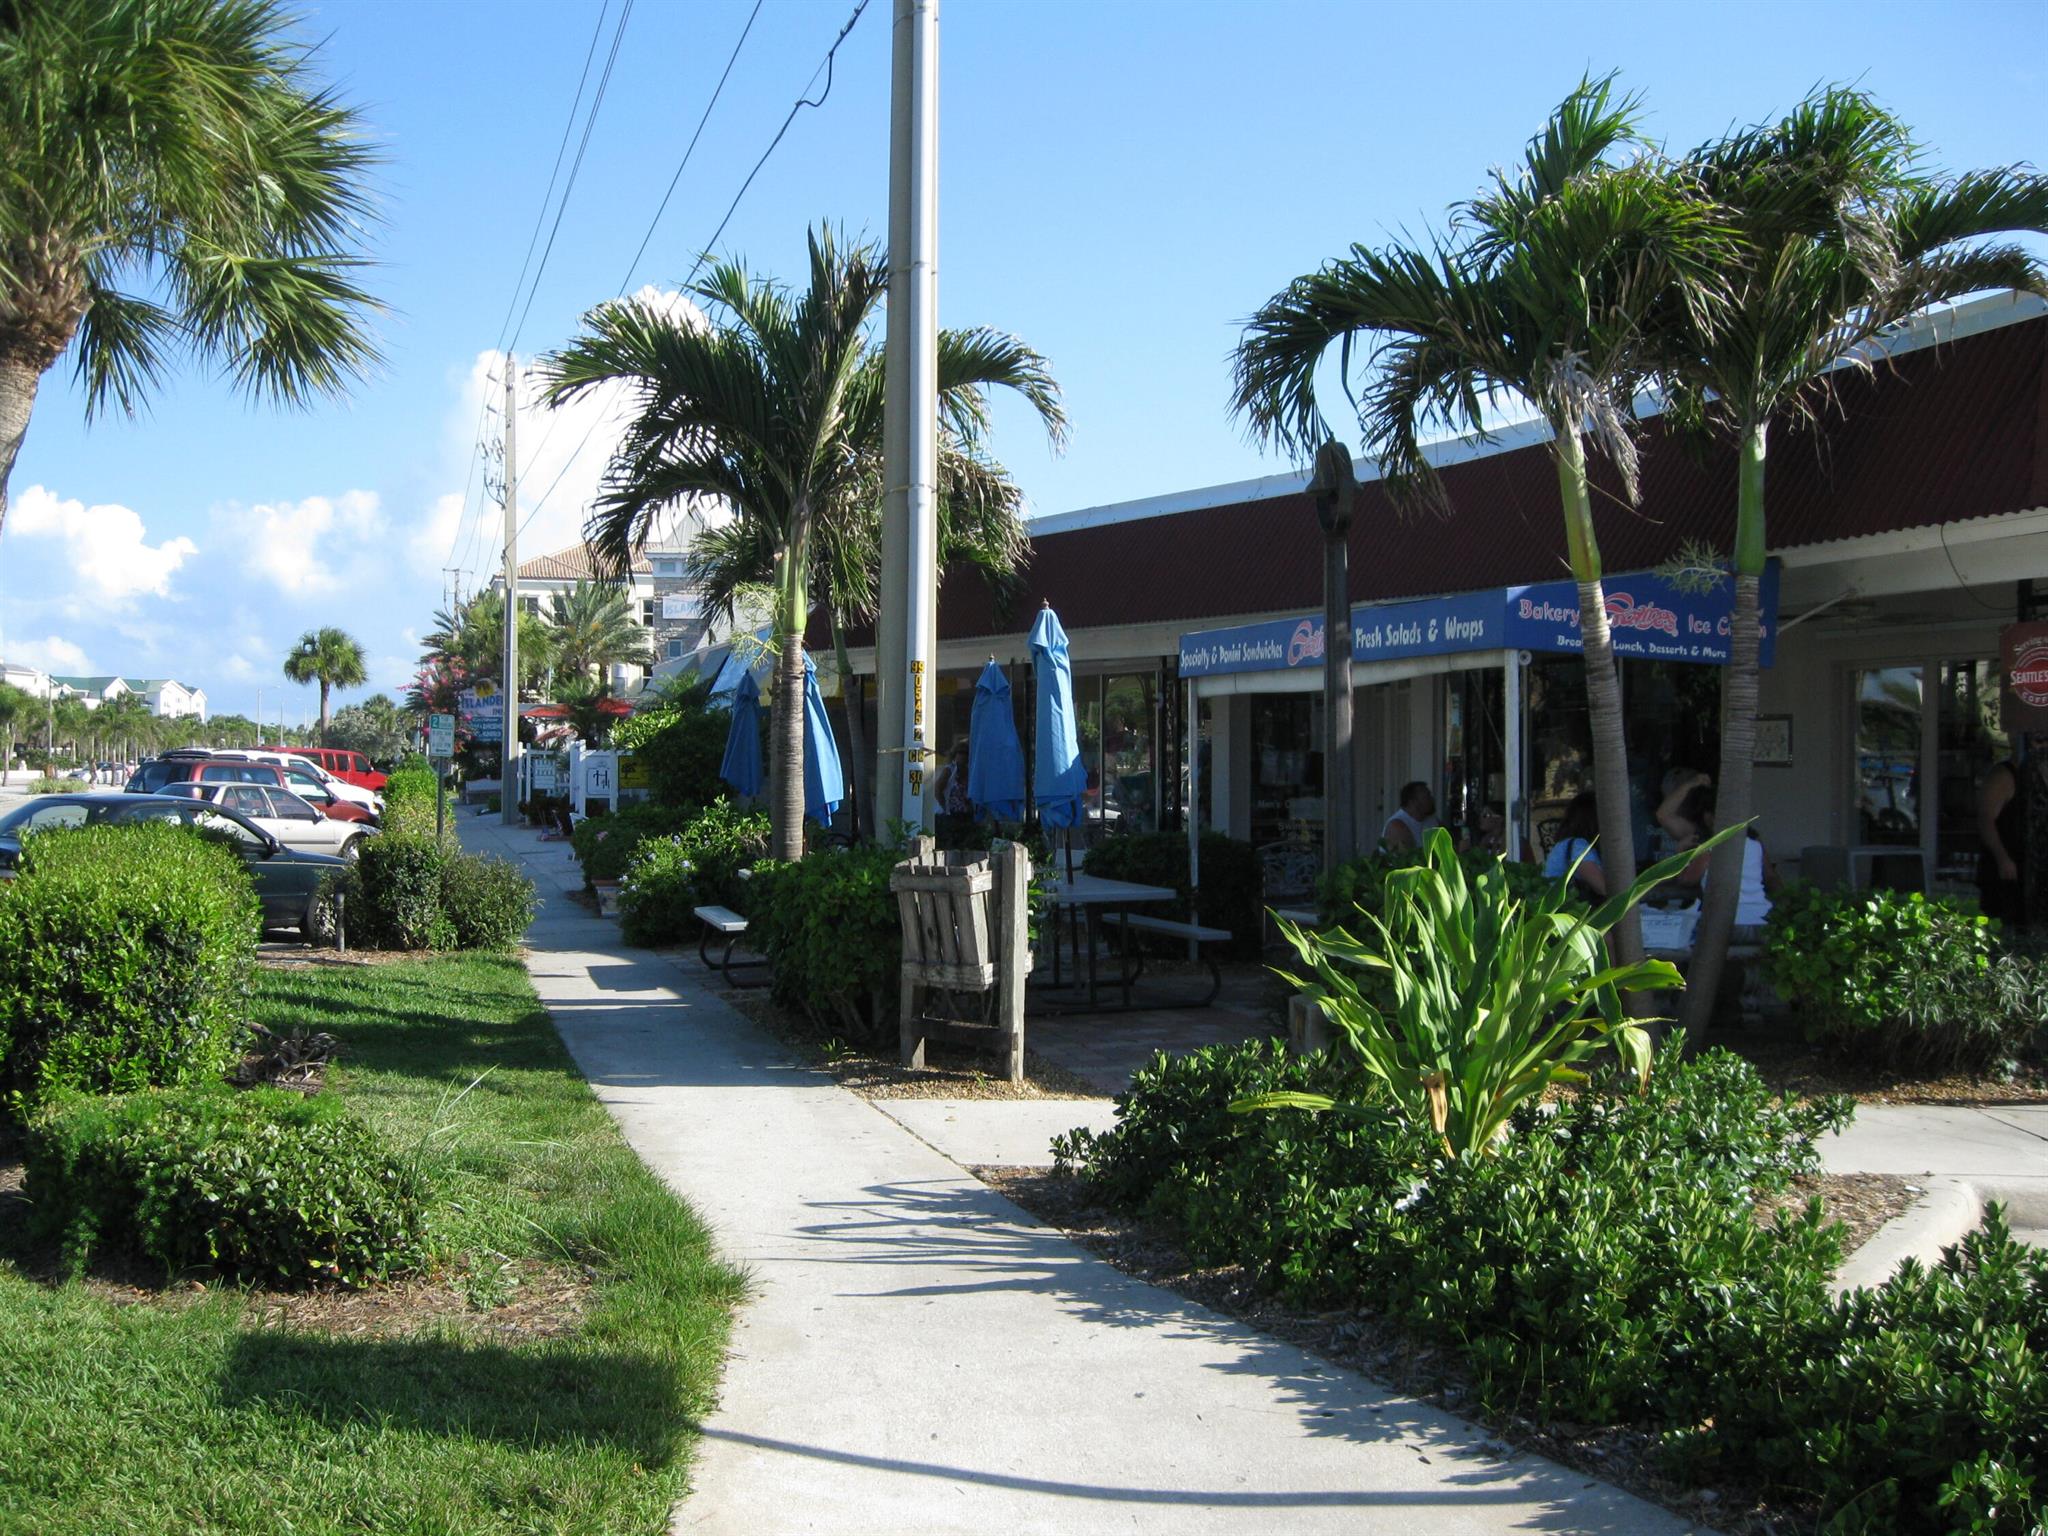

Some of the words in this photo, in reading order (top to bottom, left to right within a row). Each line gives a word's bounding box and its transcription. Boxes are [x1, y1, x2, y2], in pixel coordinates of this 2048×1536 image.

[1518, 598, 1580, 628] Bakery
[1355, 625, 1382, 649] Fresh
[1385, 621, 1422, 647] Salads
[1428, 618, 1439, 643] &
[1445, 616, 1484, 643] Wraps
[1688, 613, 1712, 634] Ice
[1180, 647, 1209, 671] Specialty
[1211, 645, 1218, 665] &
[1220, 643, 1241, 664] Panini
[1243, 641, 1283, 662] Sandwiches
[1612, 639, 1645, 653] Lunch,
[1649, 642, 1688, 656] Desserts
[1690, 645, 1700, 657] &
[1702, 647, 1727, 658] More
[911, 660, 925, 674] 99
[461, 694, 503, 708] ISLANDE
[432, 716, 439, 728] 2
